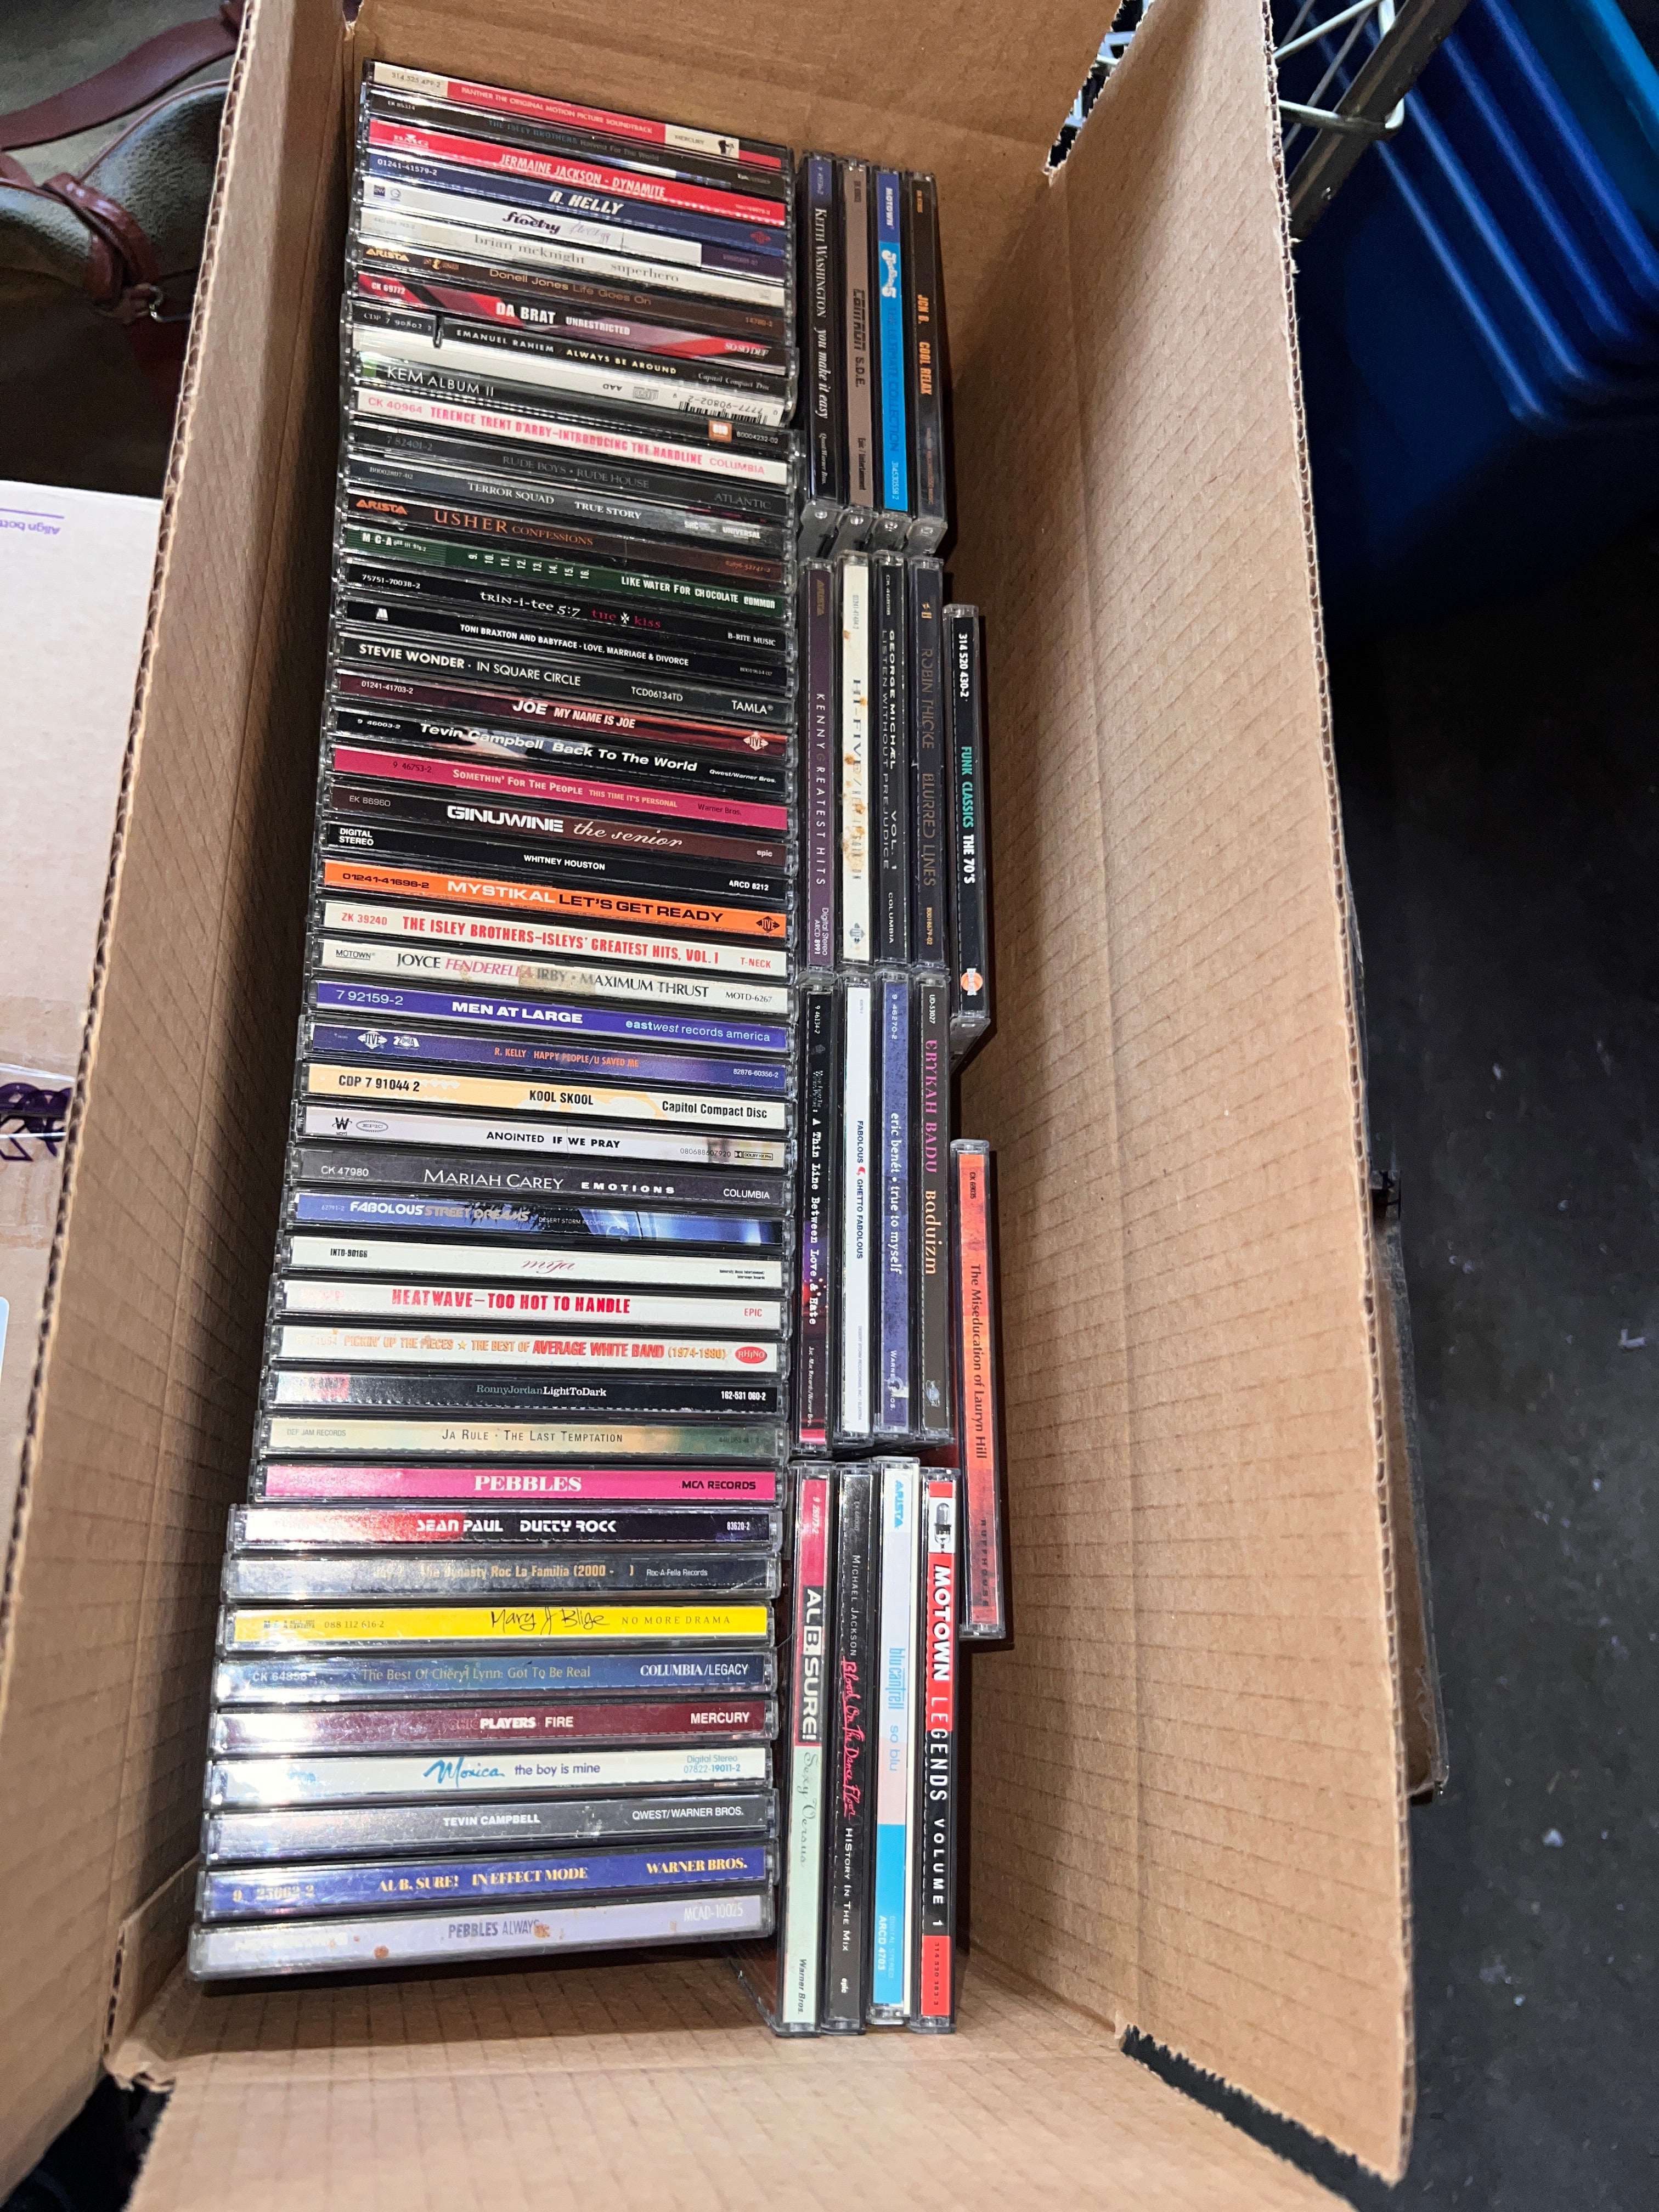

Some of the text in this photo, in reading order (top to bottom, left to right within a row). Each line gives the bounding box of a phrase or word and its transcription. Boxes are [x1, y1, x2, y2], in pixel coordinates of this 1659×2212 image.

[461, 87, 653, 133] PANTHER THE ORIGINAL MOTION PICTURE SOUNDTRACK
[377, 159, 437, 176] 01241-41579-2
[500, 154, 665, 198] JERMAINE JACKSON DYNAMITE
[496, 302, 630, 335] DA BRAT UNRESTRICTED
[456, 330, 676, 374] EMANUEL RAHIEM ALWAYS BE AROUND
[917, 295, 932, 396] JON B. COOL RELAX
[467, 482, 641, 519] TERROR SQUAD TRUE STORY
[29, 523, 61, 535] Align
[434, 509, 593, 546] USHER CONFESSIONS
[727, 632, 776, 646] B-RITE MUSIC
[359, 644, 581, 686] STEVIE WONDER IN SQUARE CIRCLE
[958, 633, 969, 697] 314 520 430-2
[512, 701, 636, 729] JOE MY NAME IS JOE
[420, 723, 698, 772] Tevin Campbell Back To The World
[961, 746, 975, 884] FUNK CLASSICS THE 70'S
[340, 828, 373, 838] DIGITAL
[447, 805, 683, 847] GINUWINE the senior
[338, 836, 374, 845] STEREO
[523, 855, 605, 871] WHITNEY HOUSTON
[729, 880, 769, 891] ARCD 8212
[447, 881, 724, 922] MYSTIKAL LET'S GET READY
[741, 957, 771, 968] T-NECK
[452, 1002, 583, 1024] MEN AT LARGE
[625, 1020, 770, 1042] eastwest records america
[733, 1069, 778, 1078] 82876-60356-2
[529, 1090, 594, 1105] KOOL SKOOL
[662, 1101, 768, 1119] Capitol Compact Disc
[487, 1131, 545, 1143] ANOINTED
[568, 1137, 586, 1146] WE
[590, 1139, 620, 1148] PRAY
[321, 1166, 369, 1177] CK 47980
[424, 1169, 675, 1194] MARIAH CAREY EMOTIONS
[723, 1188, 770, 1199] COLUMBIA
[887, 1113, 902, 1274] eric benét true to myself
[330, 1248, 368, 1258] INTD-90166
[970, 1264, 981, 1285] The
[744, 1308, 763, 1317] EPIC
[971, 1289, 984, 1370] Miseducation
[532, 1340, 727, 1359] AVERAGE WHITE BAND (1974-1980)
[974, 1375, 984, 1386] of
[971, 1391, 985, 1432] Lauryn
[975, 1436, 986, 1459] Hill
[473, 1475, 756, 1492] PEBBLES MCA RECORDS
[727, 1521, 750, 1530] 83620-2
[646, 1568, 708, 1577] Roc-A-Fella Records
[850, 1555, 860, 1656] MICHAEL JACKSON
[621, 1615, 731, 1625] NO MORE DRAMA
[933, 1566, 950, 1681] MOTOWN
[640, 1663, 748, 1676] COLUMBIA/LEGACY
[691, 1712, 750, 1724] MERCURY
[885, 1649, 906, 1771] blu cantrell so blu
[479, 1716, 574, 1729] PLAYERS FIRE
[930, 1697, 948, 1800] LEGENDS
[422, 1757, 600, 1788] Monica the boy is mine
[443, 1814, 541, 1827] TEVIN CAMPBELL
[646, 1858, 748, 1874] WARNER BROS.
[933, 1819, 945, 1905] VOLUME
[448, 1919, 539, 1939] PEBBLES ALWAYS
[798, 1959, 807, 1990] Warner
